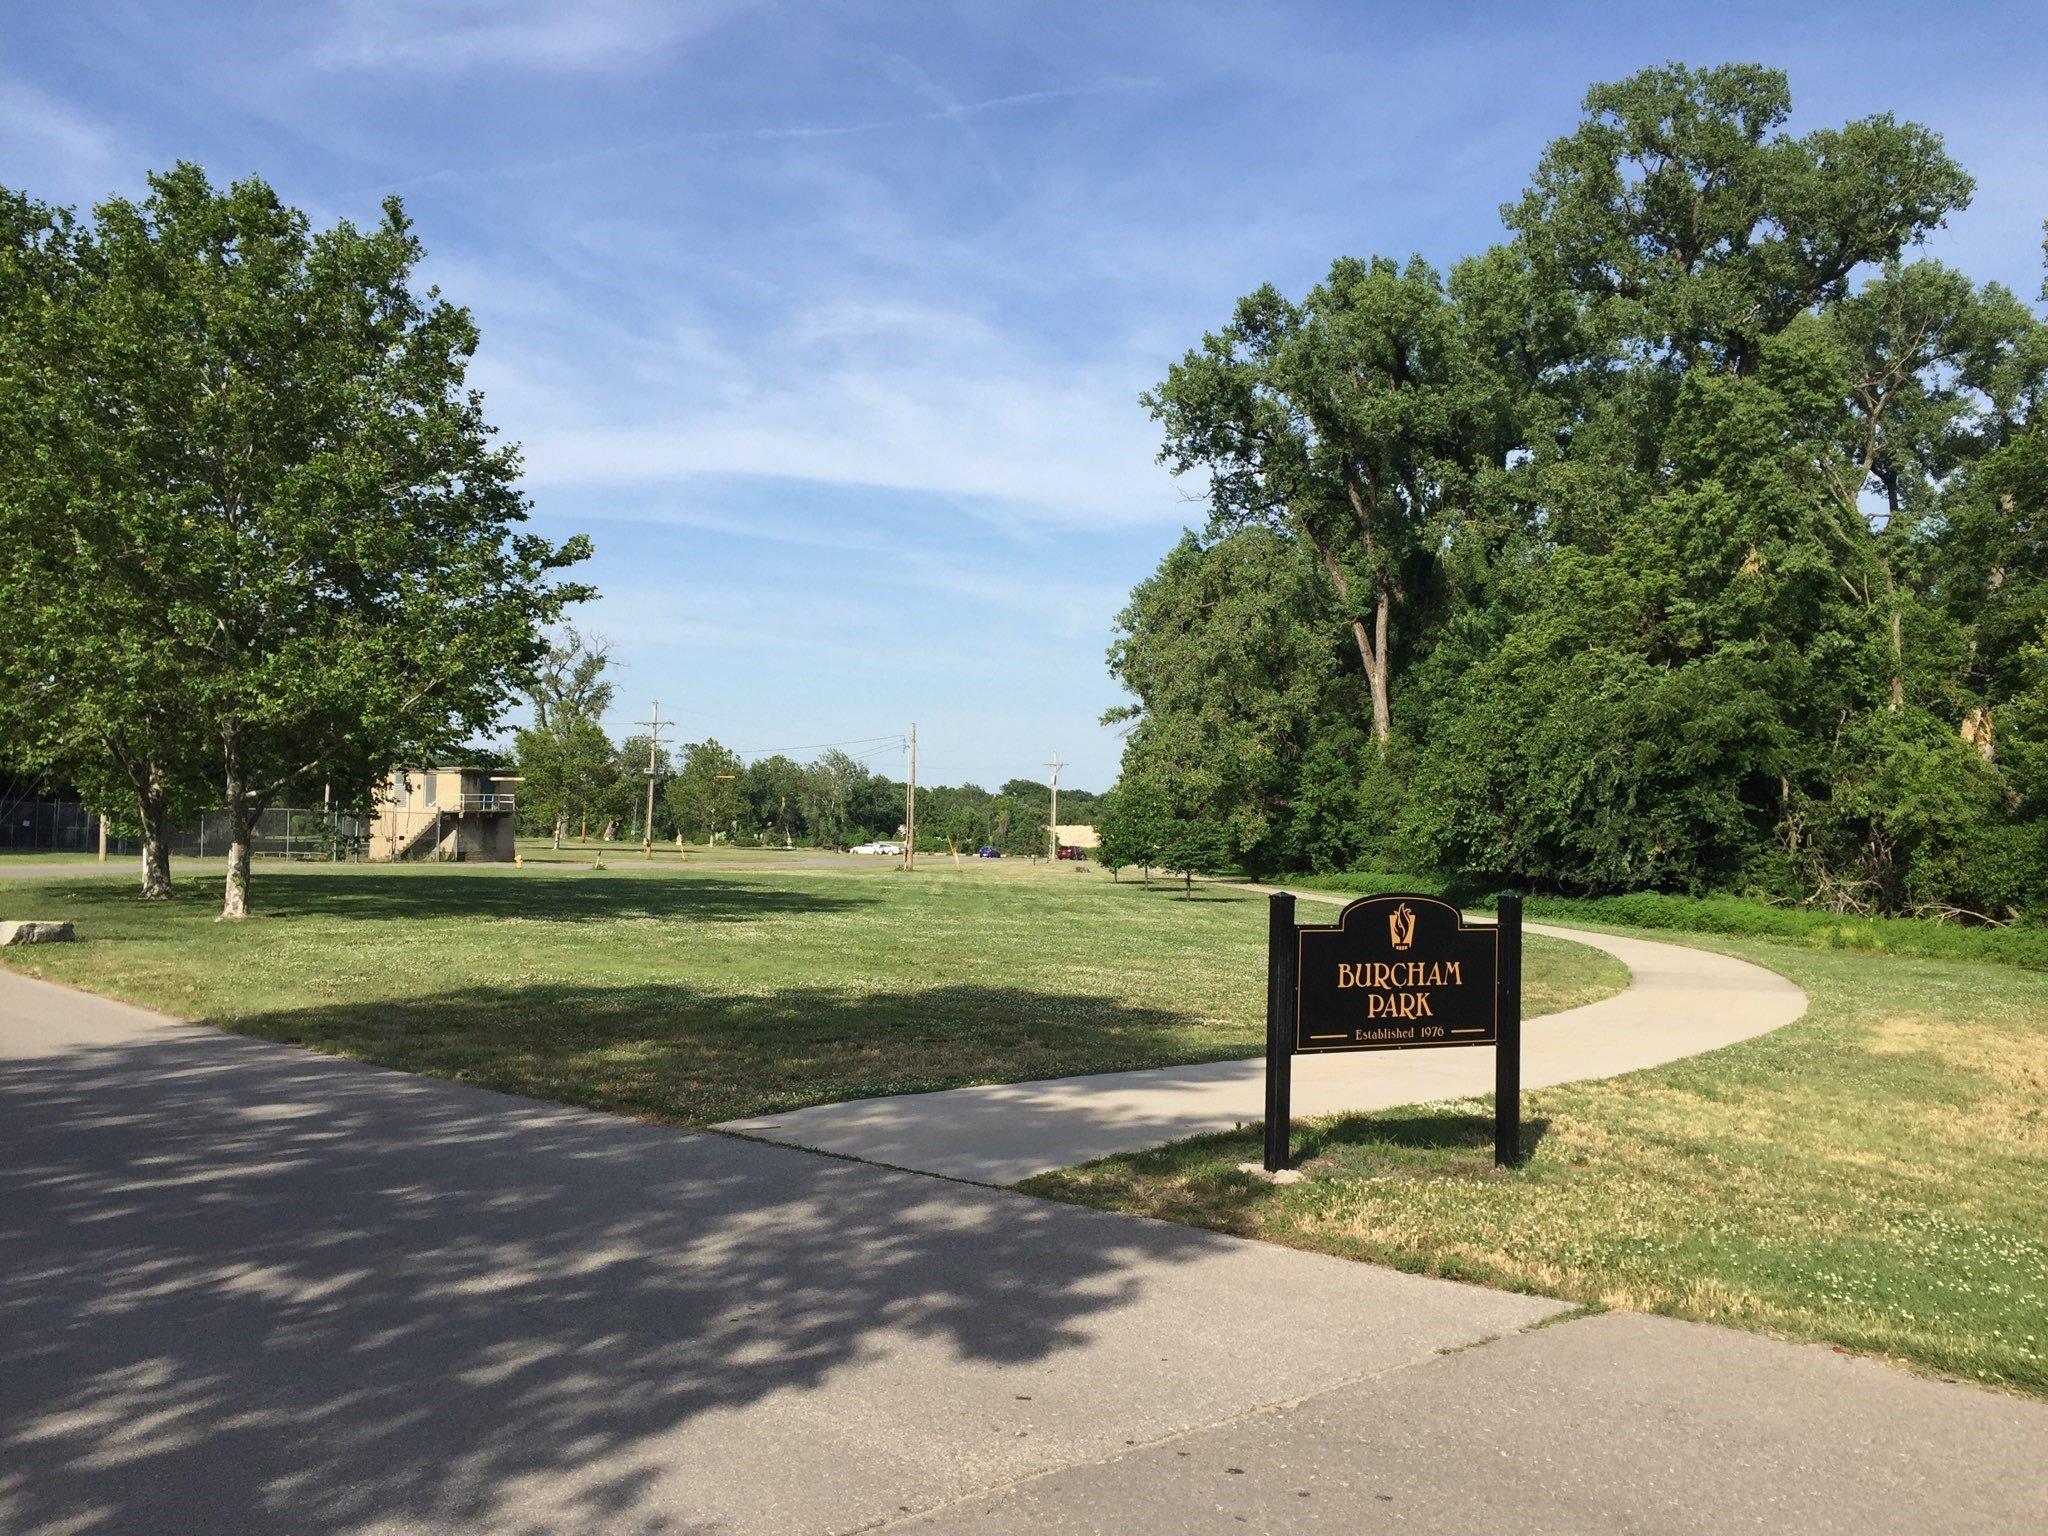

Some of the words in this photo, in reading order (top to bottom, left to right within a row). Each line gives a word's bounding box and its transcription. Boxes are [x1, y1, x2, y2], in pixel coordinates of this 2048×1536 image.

[1338, 962, 1462, 989] BURCHAM
[1368, 993, 1433, 1019] PARK
[1356, 1027, 1414, 1040] Established
[1421, 1026, 1444, 1037] 1976
